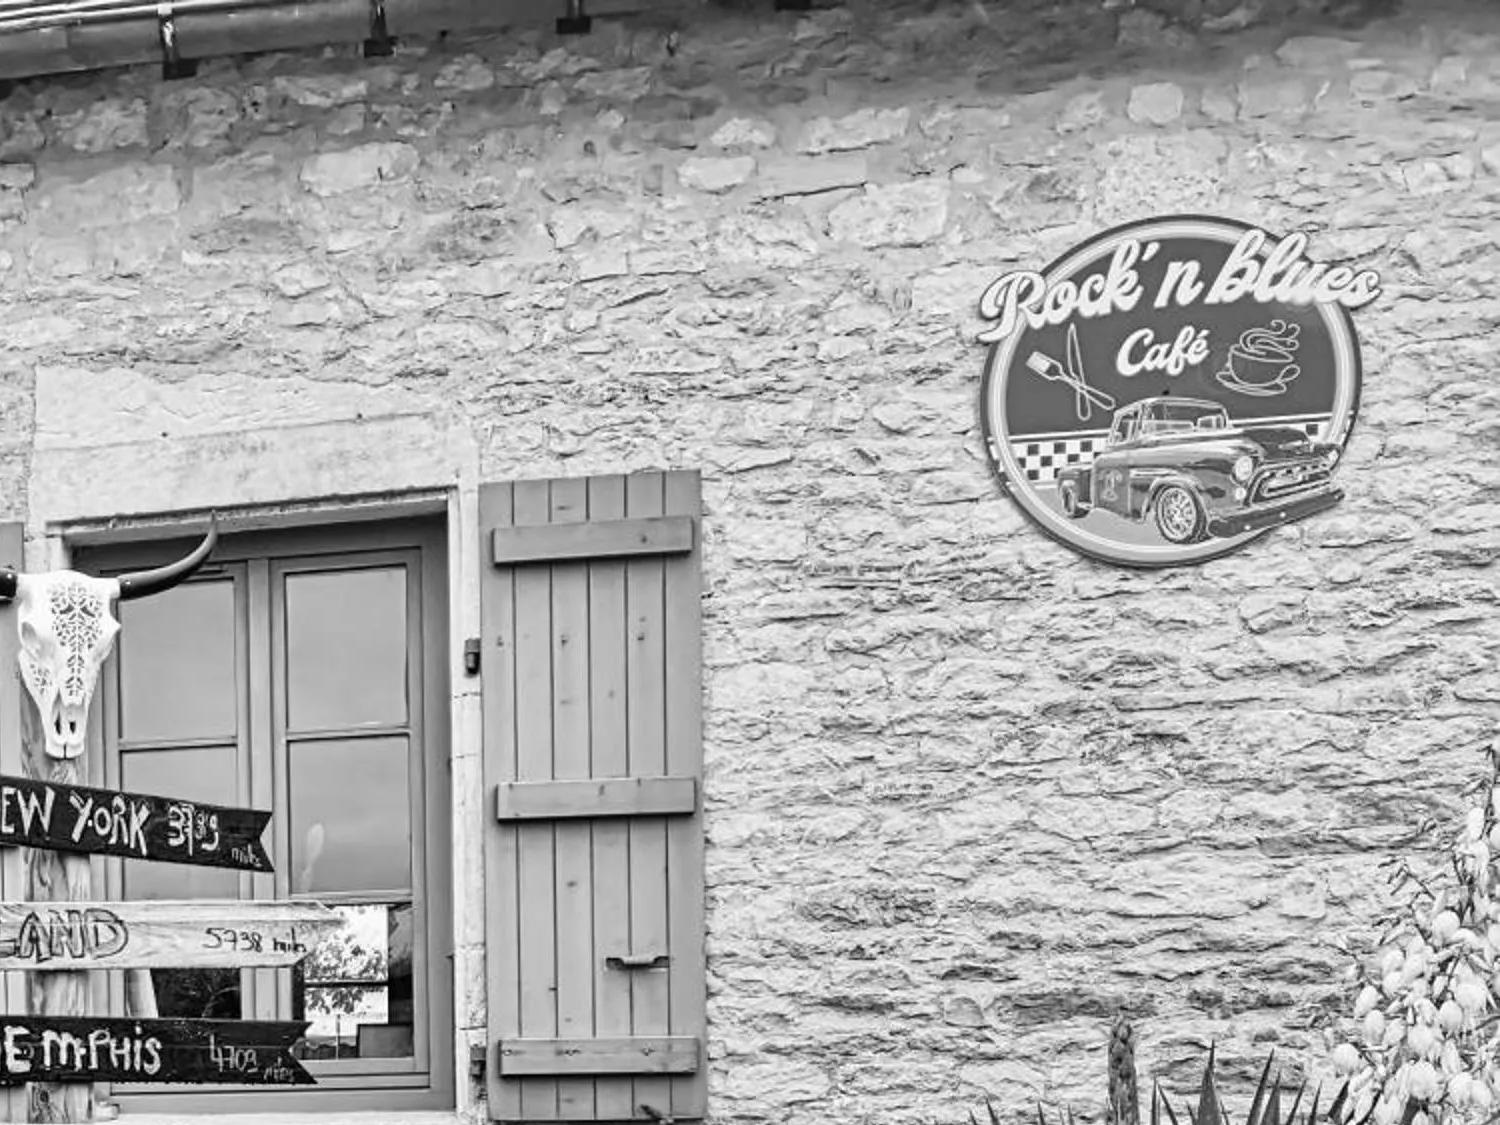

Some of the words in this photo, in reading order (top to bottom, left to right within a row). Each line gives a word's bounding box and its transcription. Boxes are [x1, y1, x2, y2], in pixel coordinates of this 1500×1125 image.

[1204, 229, 1381, 308] blues
[1116, 325, 1210, 376] Café
[69, 792, 151, 856] YORK
[202, 927, 263, 953] 5738
